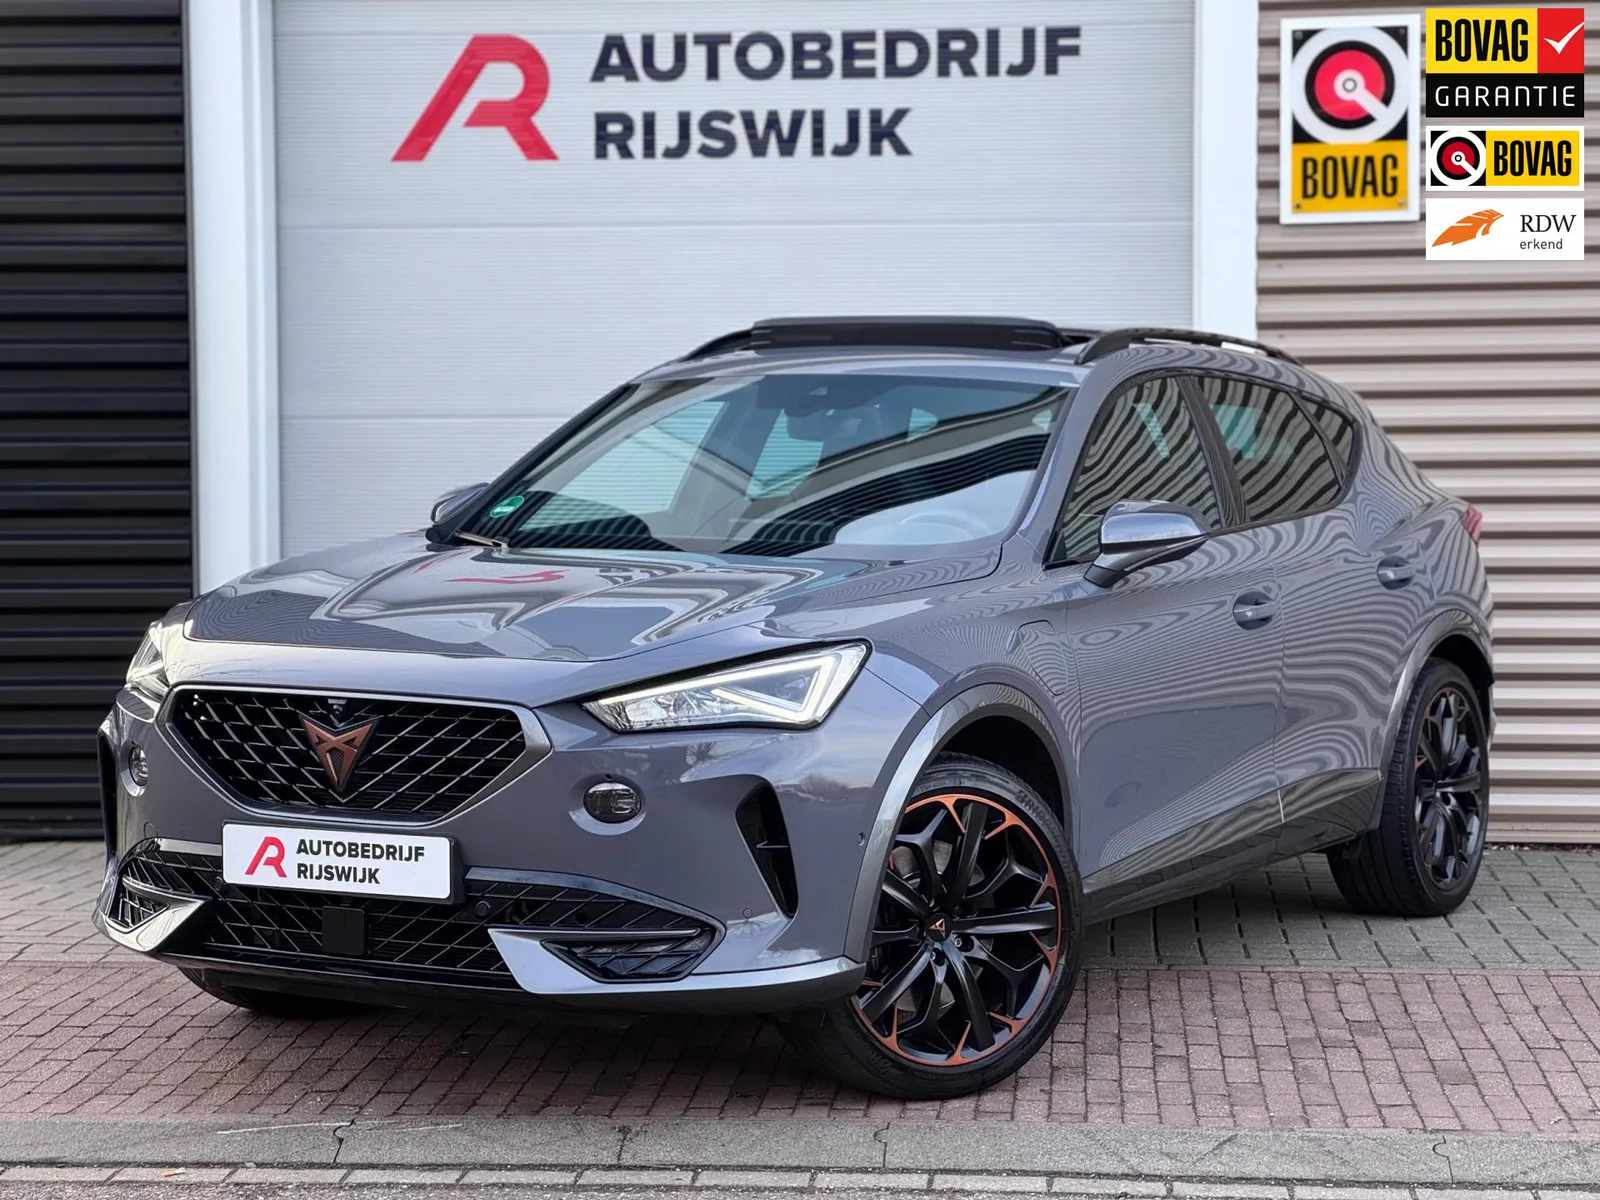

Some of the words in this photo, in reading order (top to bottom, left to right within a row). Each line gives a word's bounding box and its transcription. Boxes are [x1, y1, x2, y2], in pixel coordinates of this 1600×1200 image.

[590, 26, 1081, 83] AUTOBEDRIJF
[593, 107, 913, 160] RIJSWIJK
[1301, 153, 1399, 200] BOVAG
[296, 838, 425, 862] AUTOBEDRIJF
[296, 862, 380, 885] RIJSWIJK
